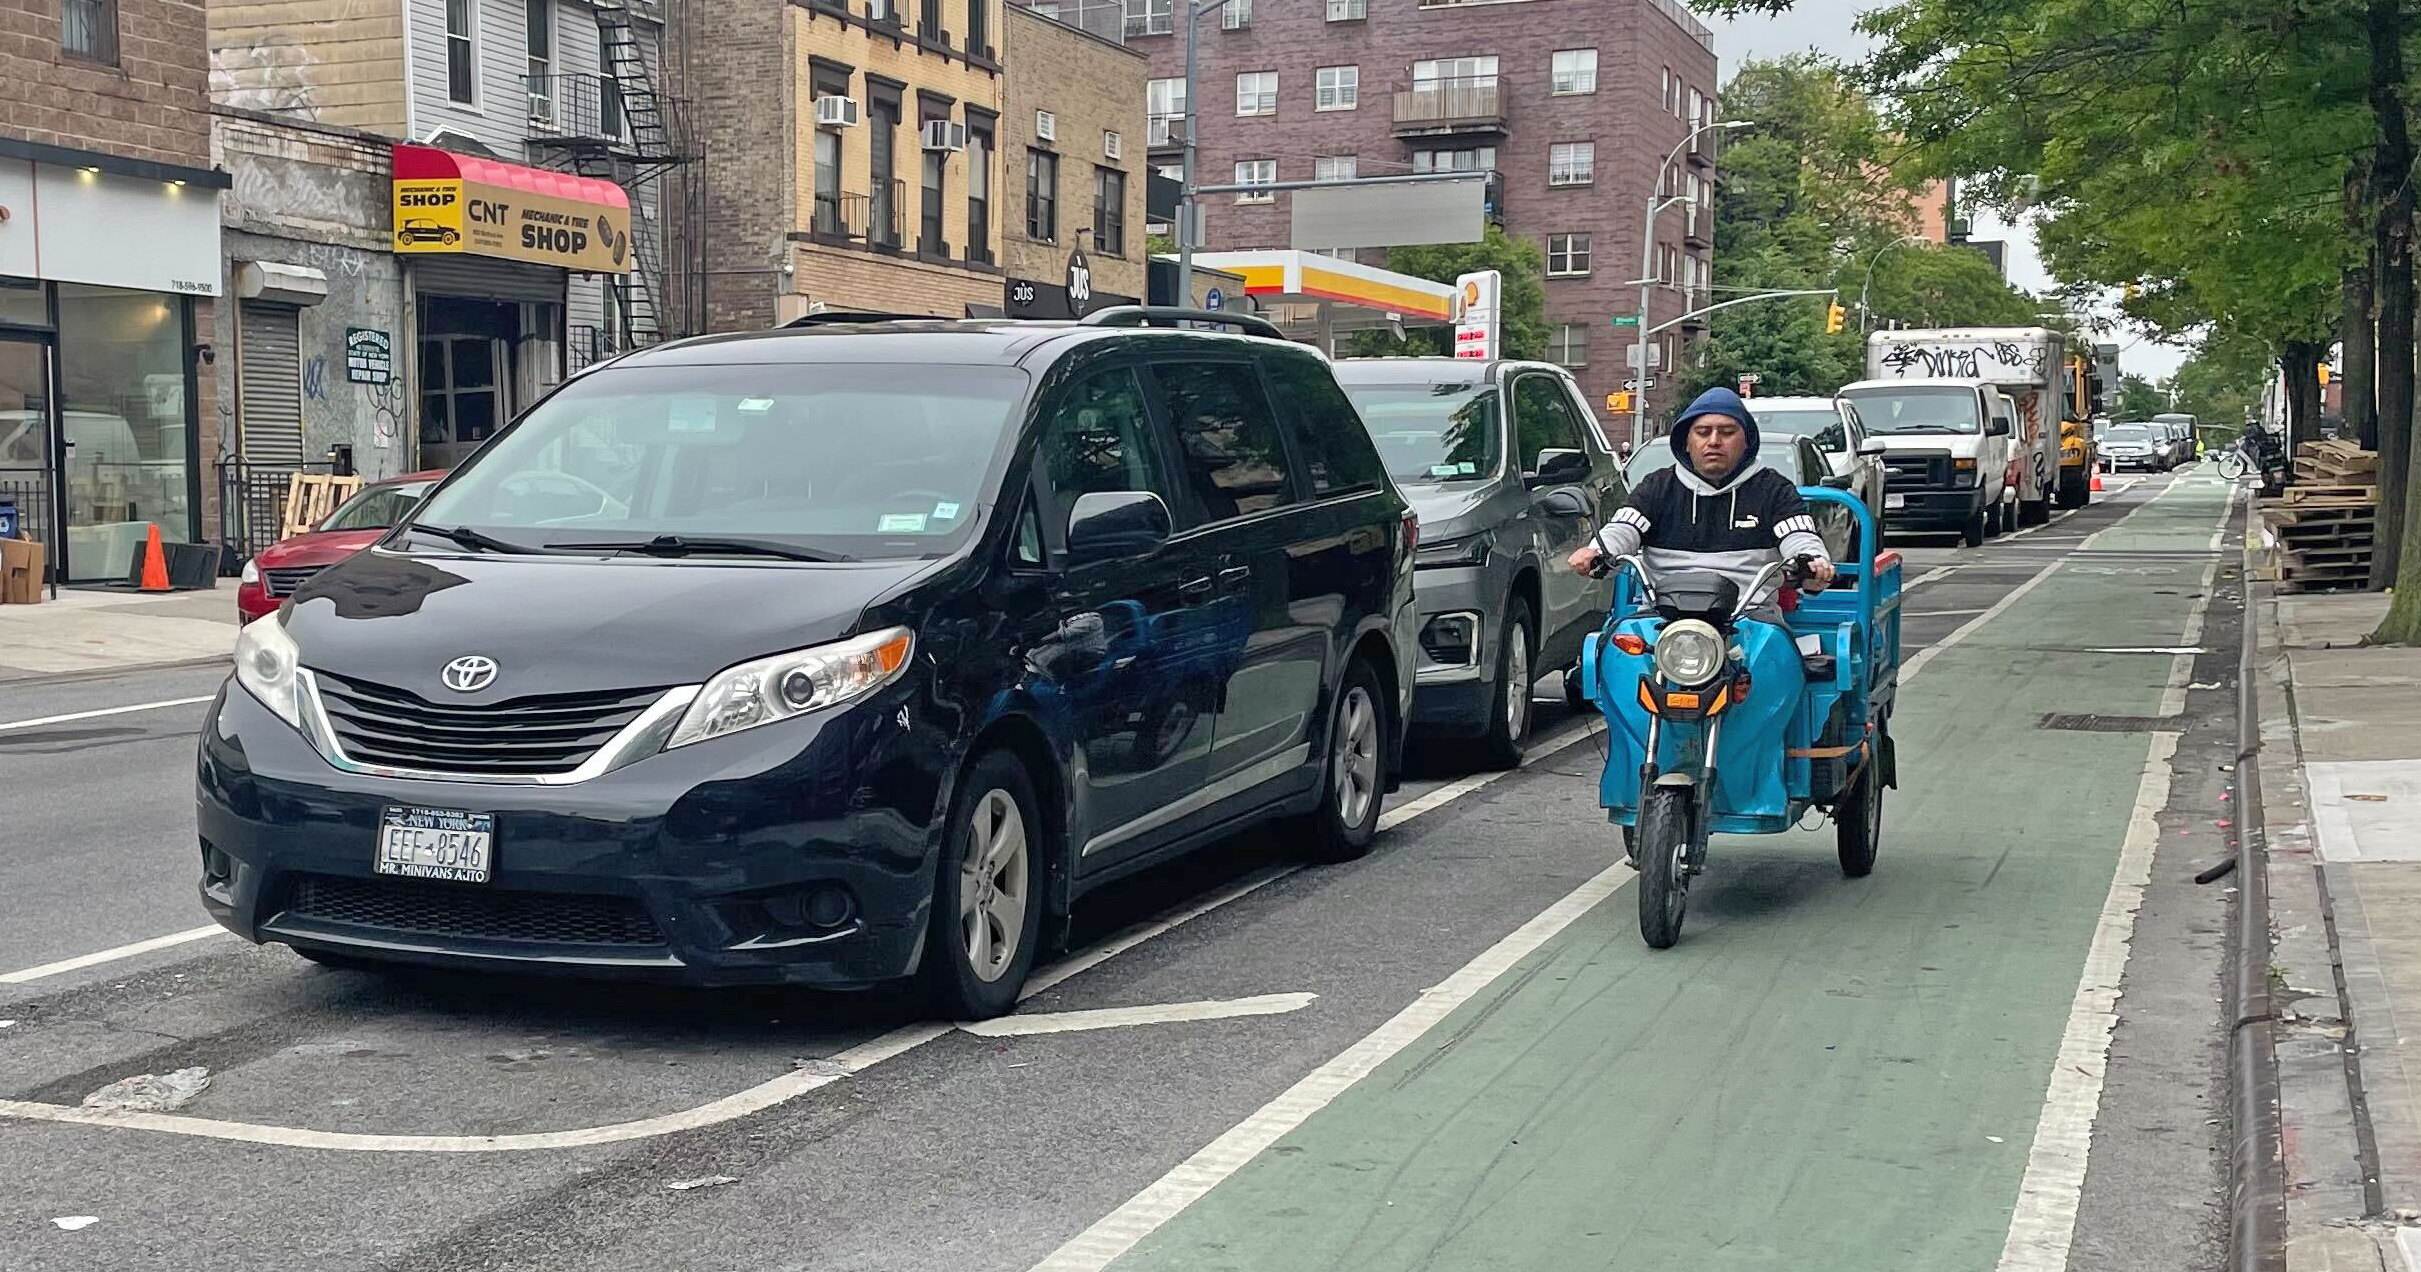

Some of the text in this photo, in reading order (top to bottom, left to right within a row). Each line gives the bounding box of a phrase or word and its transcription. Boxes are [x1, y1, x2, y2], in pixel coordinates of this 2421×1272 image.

[400, 194, 456, 206] SHOP
[468, 199, 509, 226] CNT
[521, 209, 564, 225] MECHANIC
[571, 216, 590, 228] TIRE
[521, 224, 587, 254] SHOP
[348, 331, 389, 350] REGISTERED
[369, 359, 389, 370] VEHICLE
[406, 815, 468, 831] NEW YORK
[401, 864, 453, 880] MINIVANS
